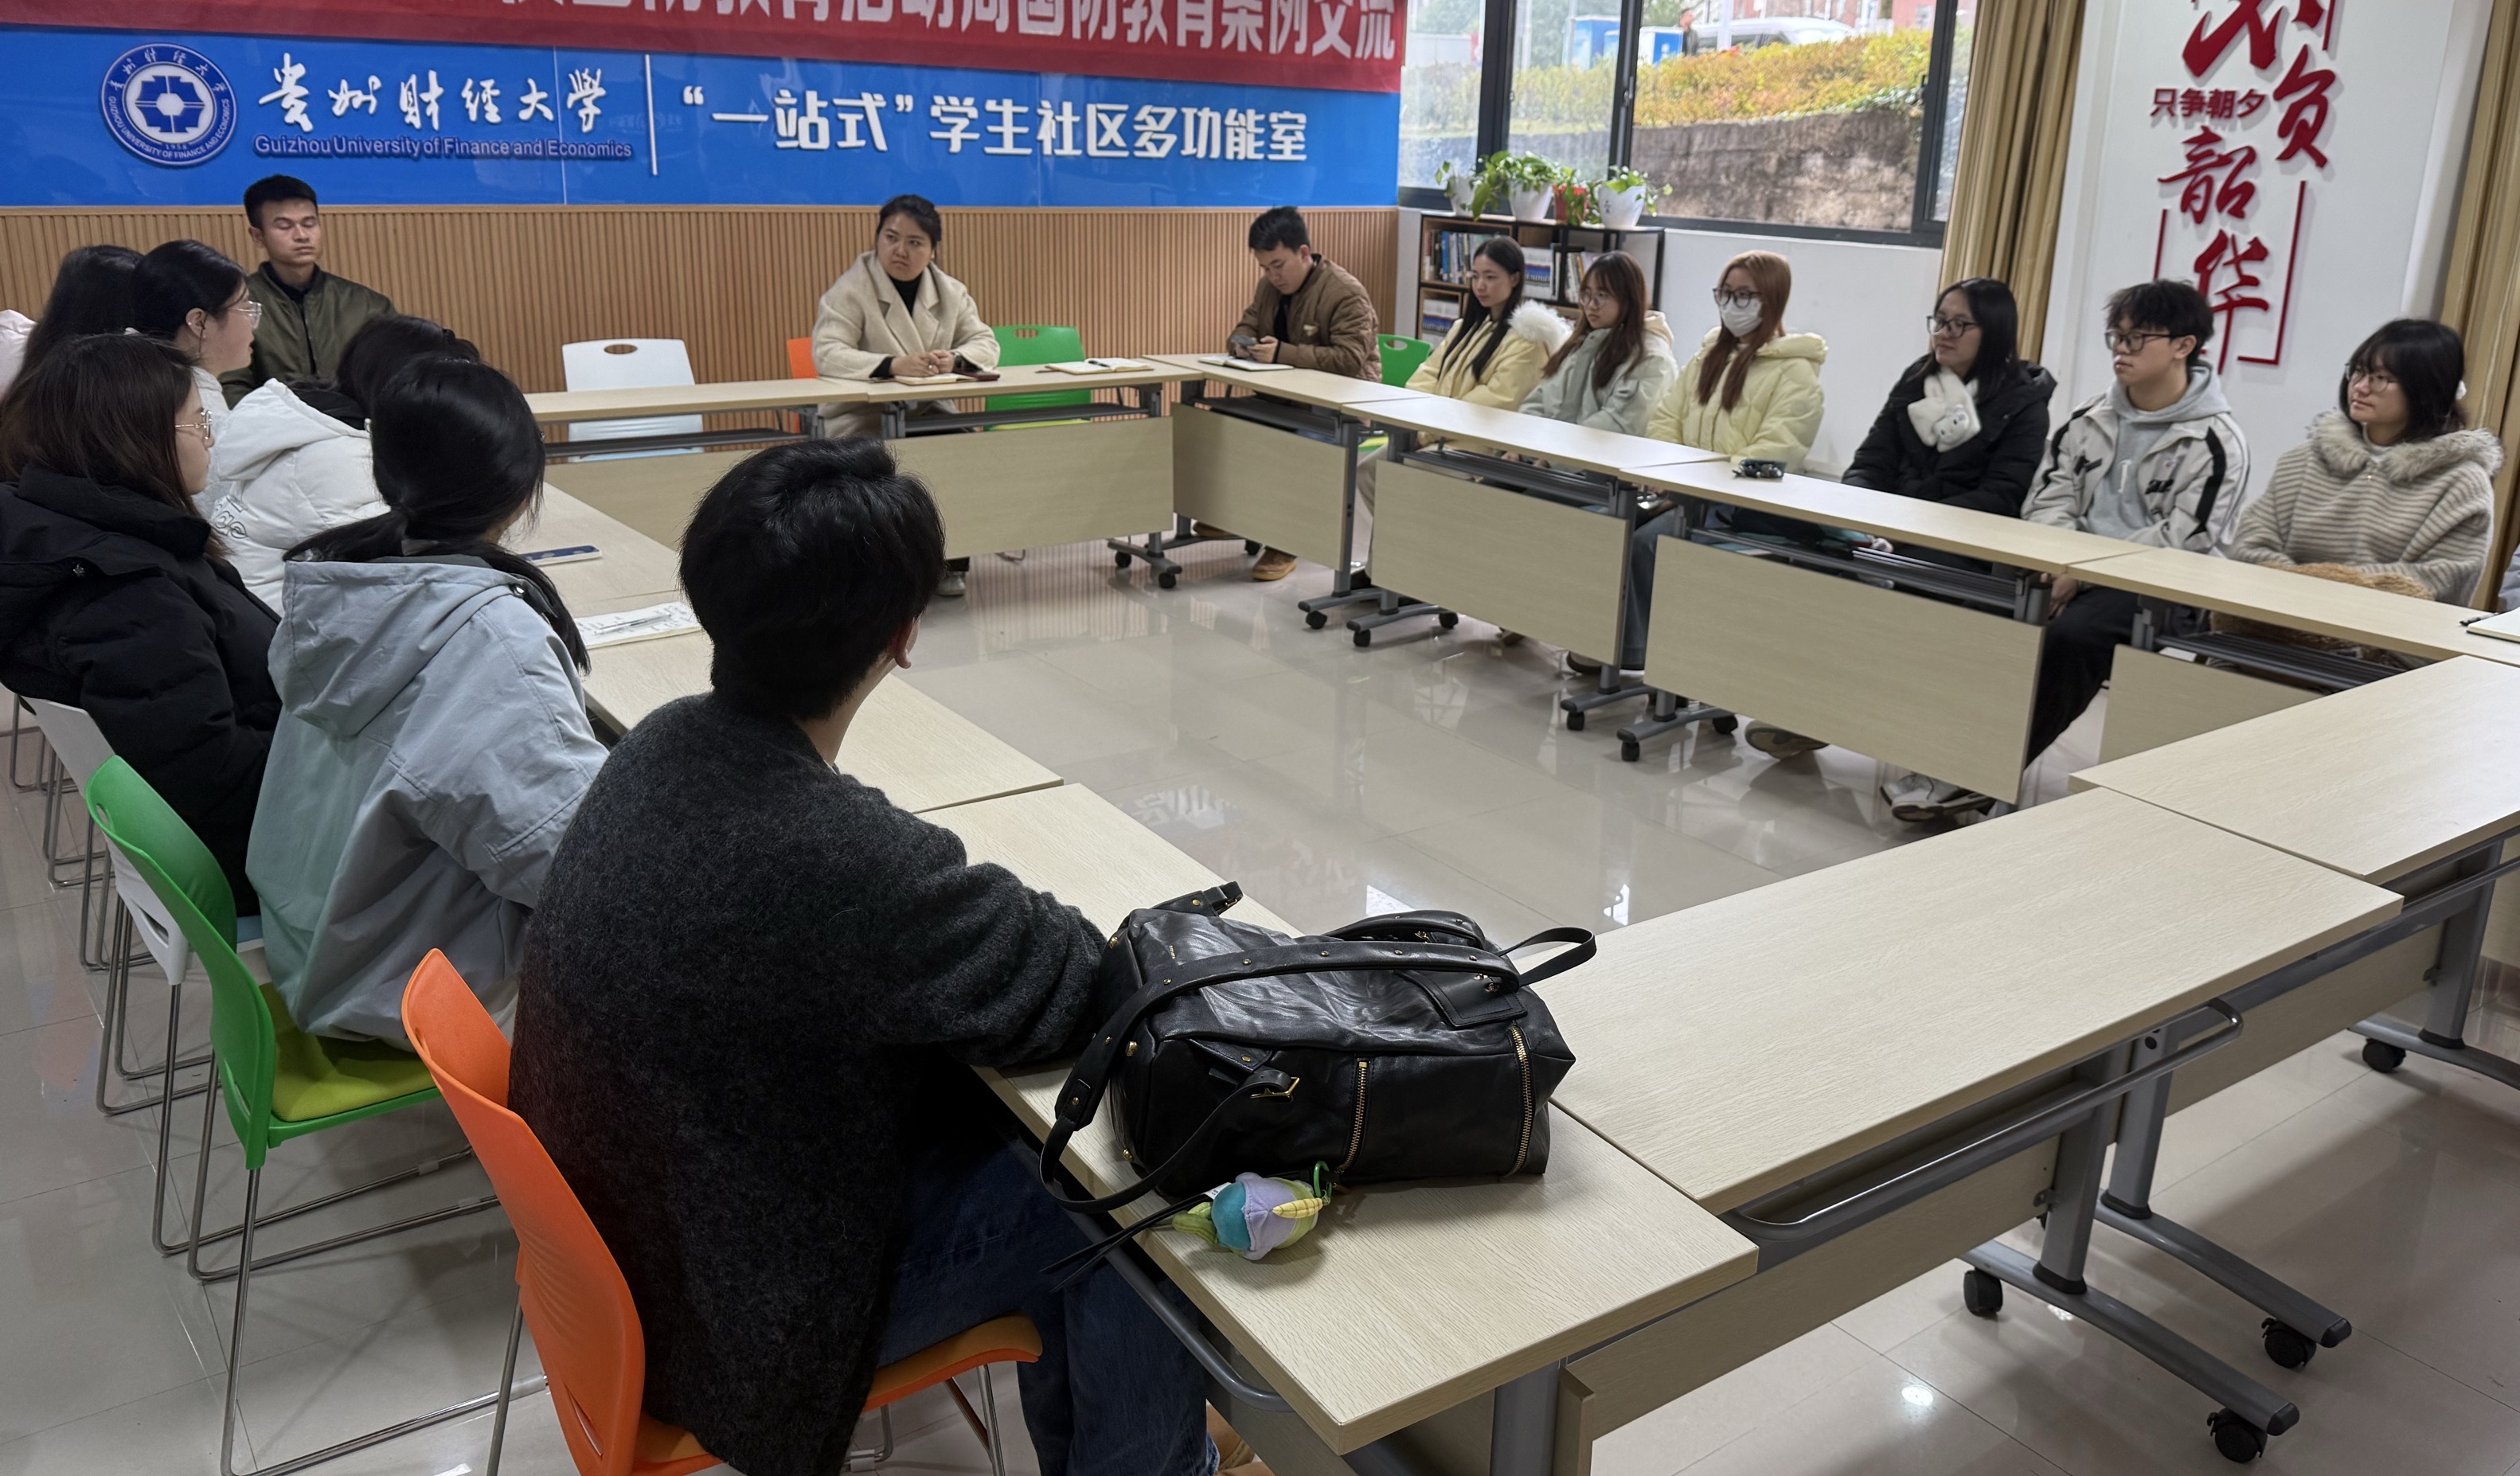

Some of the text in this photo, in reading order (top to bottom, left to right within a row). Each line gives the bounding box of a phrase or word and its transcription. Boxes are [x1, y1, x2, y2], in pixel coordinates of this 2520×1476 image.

[2151, 88, 2268, 119] 只争朝夕
[121, 126, 162, 155] UNIVERSITY
[162, 150, 174, 158] OF
[174, 146, 209, 158] FINANCE
[206, 137, 219, 149] AND
[215, 98, 230, 140] ECONOMICS
[255, 136, 632, 157] Guizhou University of Finance and Economics
